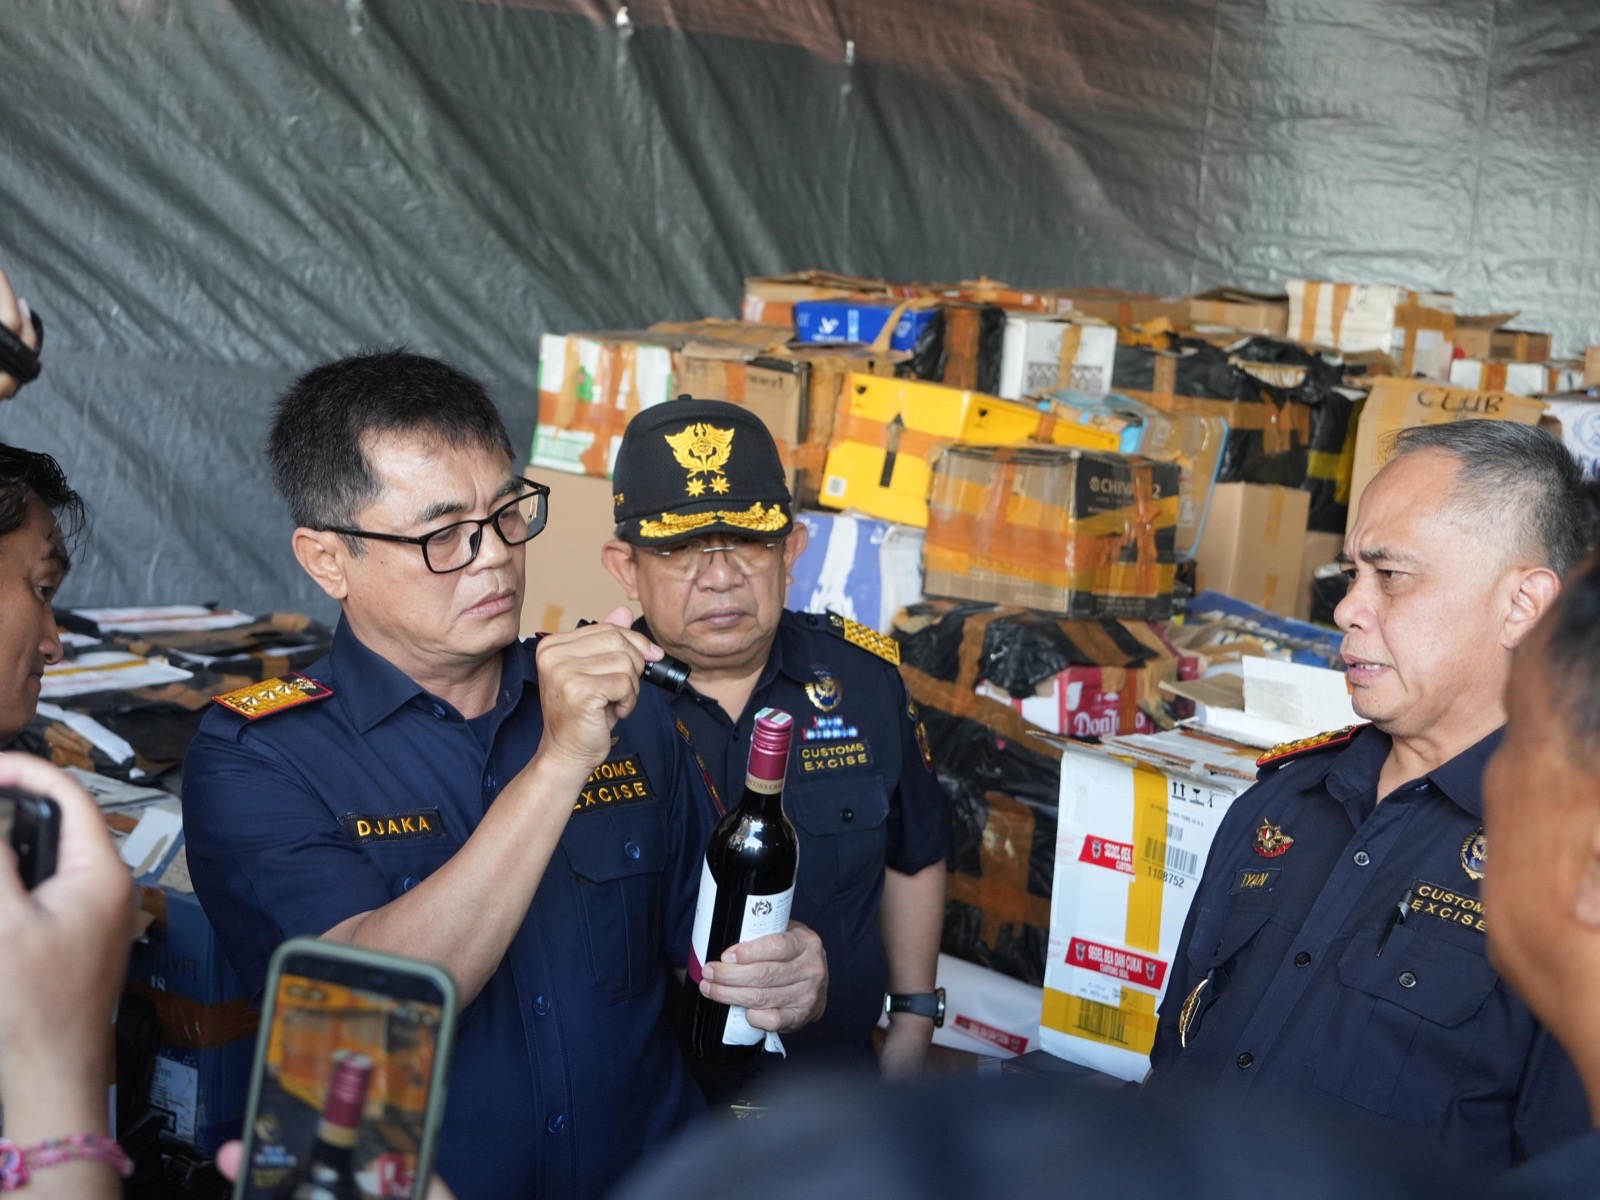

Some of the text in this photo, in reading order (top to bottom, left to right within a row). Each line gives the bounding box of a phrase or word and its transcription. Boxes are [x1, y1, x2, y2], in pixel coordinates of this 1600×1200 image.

[1100, 477, 1134, 495] CHIV
[801, 743, 865, 759] CUSTOMS
[587, 760, 637, 782] TOMS
[804, 753, 867, 772] EXCISE
[356, 815, 432, 837] DJAKA
[1147, 865, 1185, 889] 1108752
[1418, 885, 1486, 914] CUSTOM
[1411, 900, 1488, 932] EXCISE
